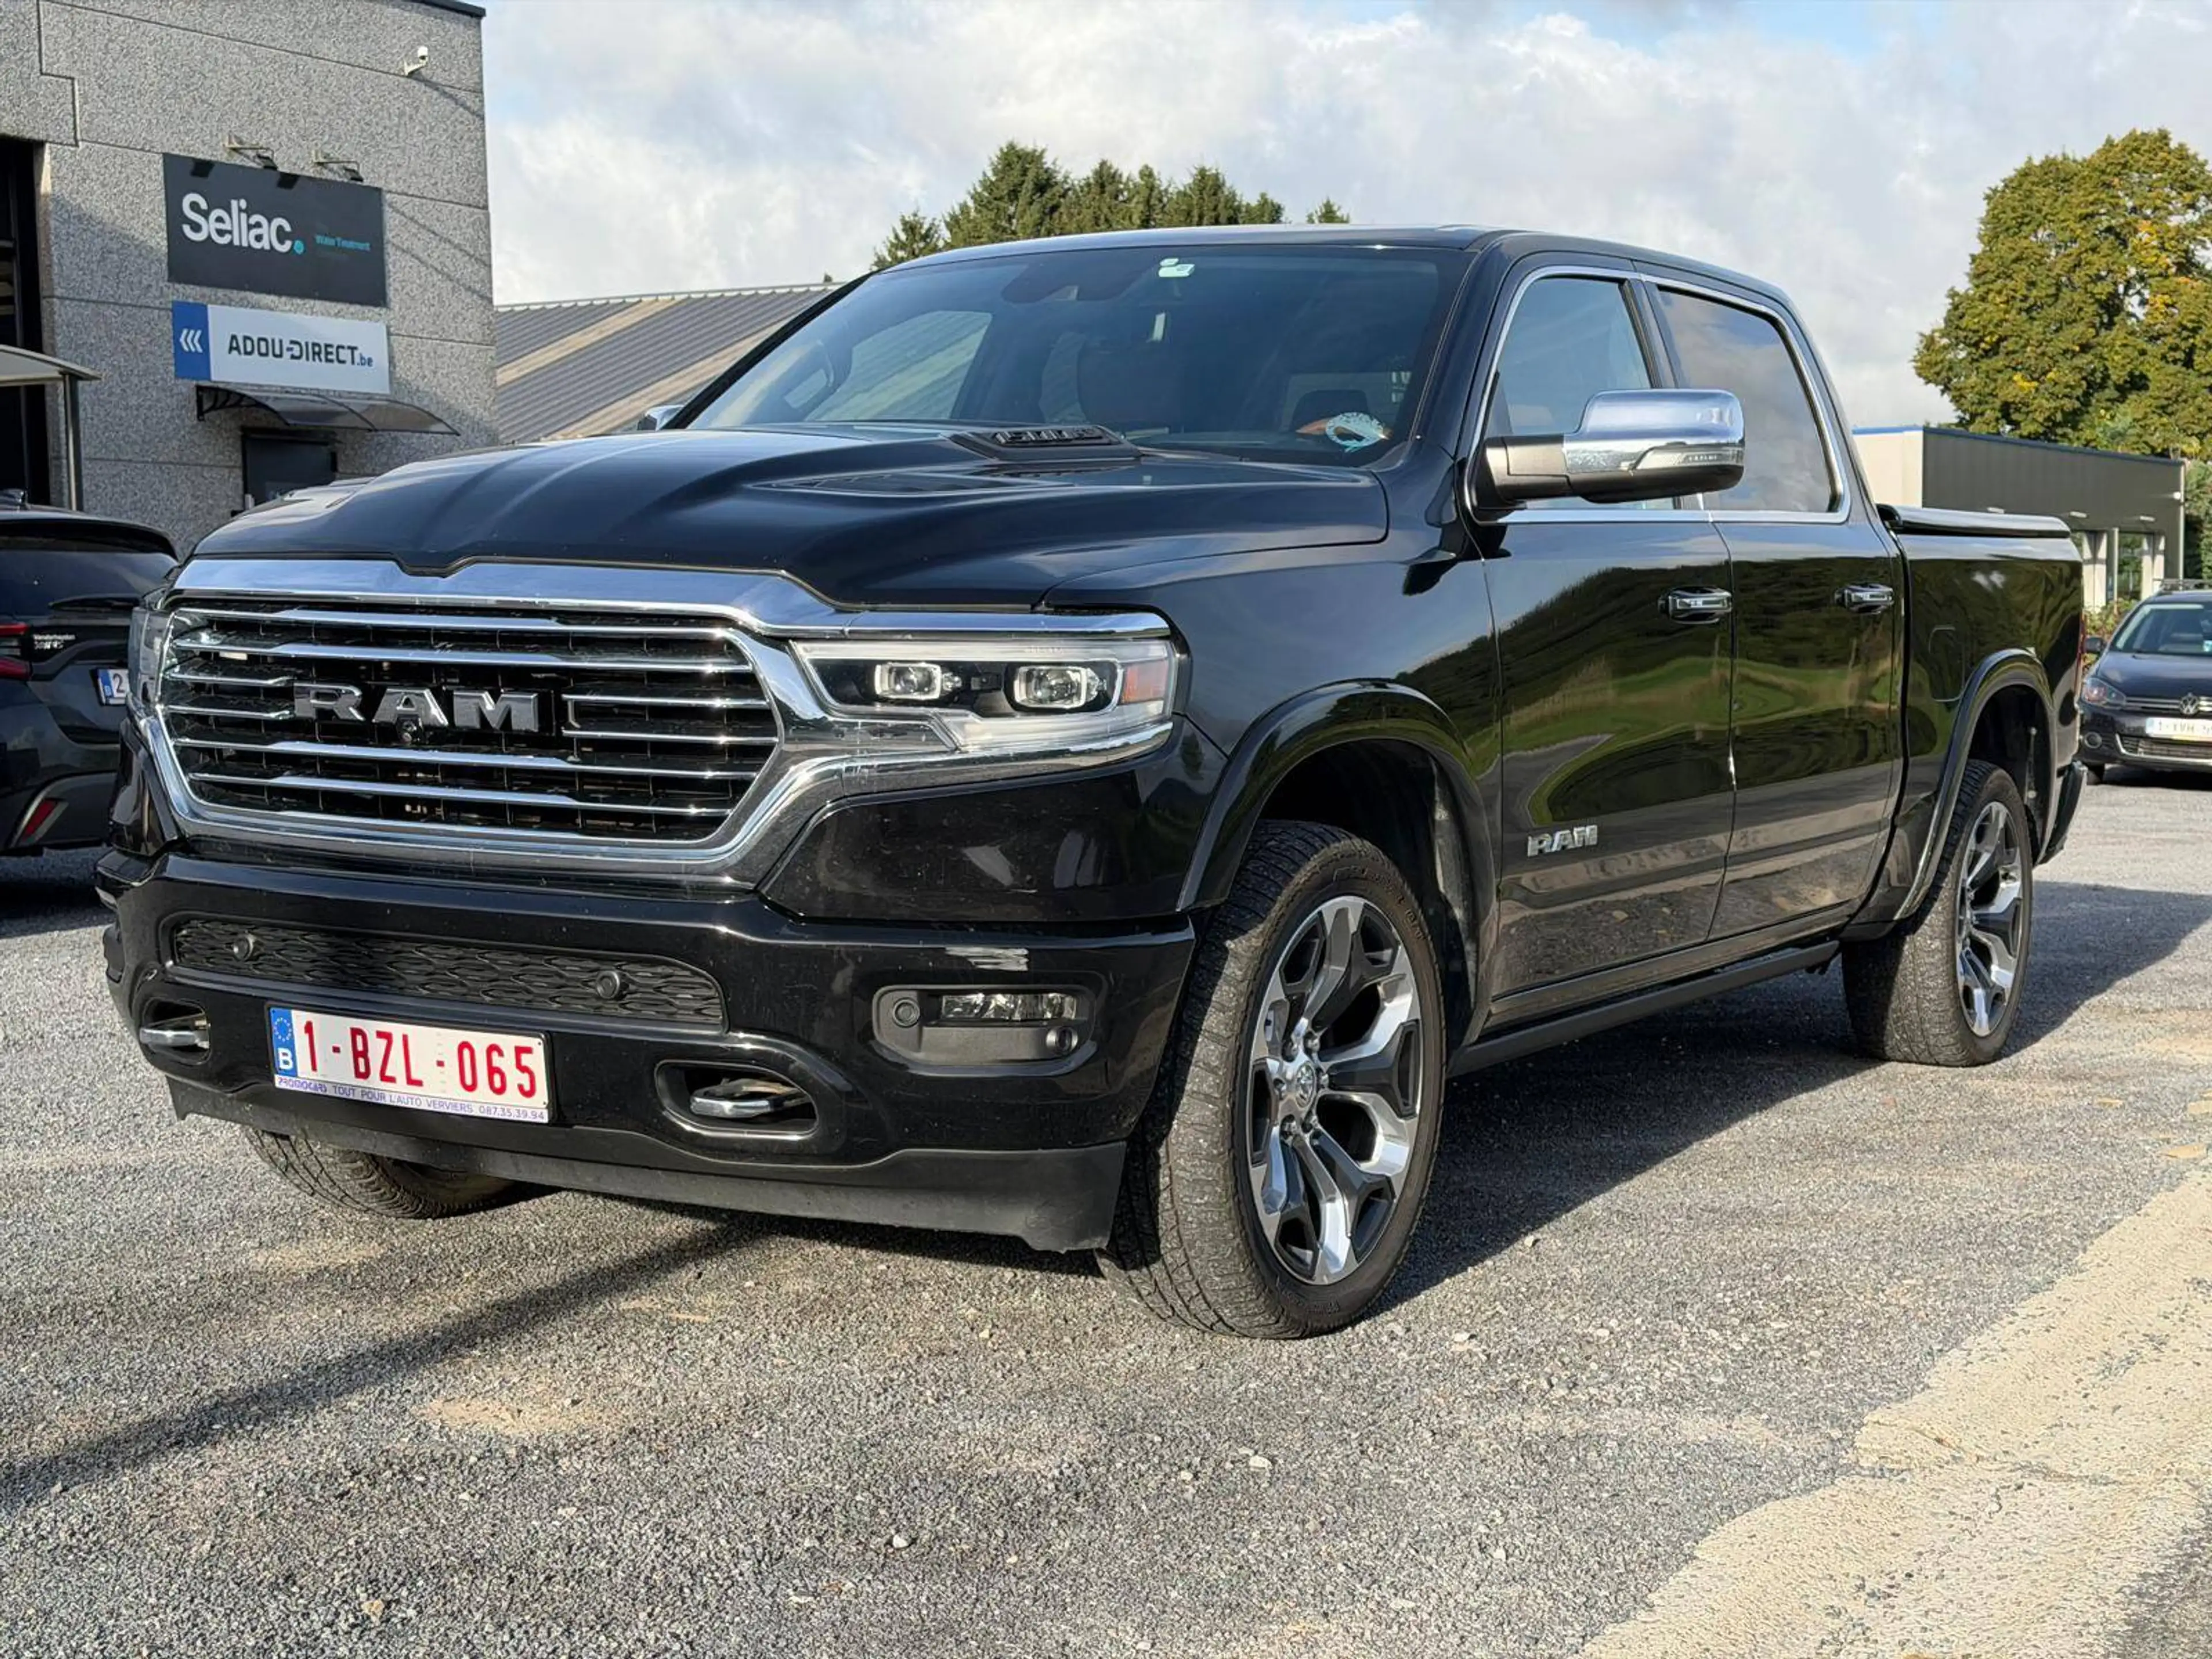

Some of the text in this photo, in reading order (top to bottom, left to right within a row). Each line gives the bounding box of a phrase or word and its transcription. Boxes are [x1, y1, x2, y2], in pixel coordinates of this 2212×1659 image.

[294, 681, 539, 733] RAM
[1528, 825, 1597, 857] RAM
[278, 1048, 294, 1070] B
[304, 1020, 536, 1099] 1-BZL-065
[333, 1085, 355, 1097] TOUT
[361, 1089, 386, 1102] POUR
[389, 1093, 422, 1107] L'AUTO
[426, 1099, 474, 1113] VERVIERS
